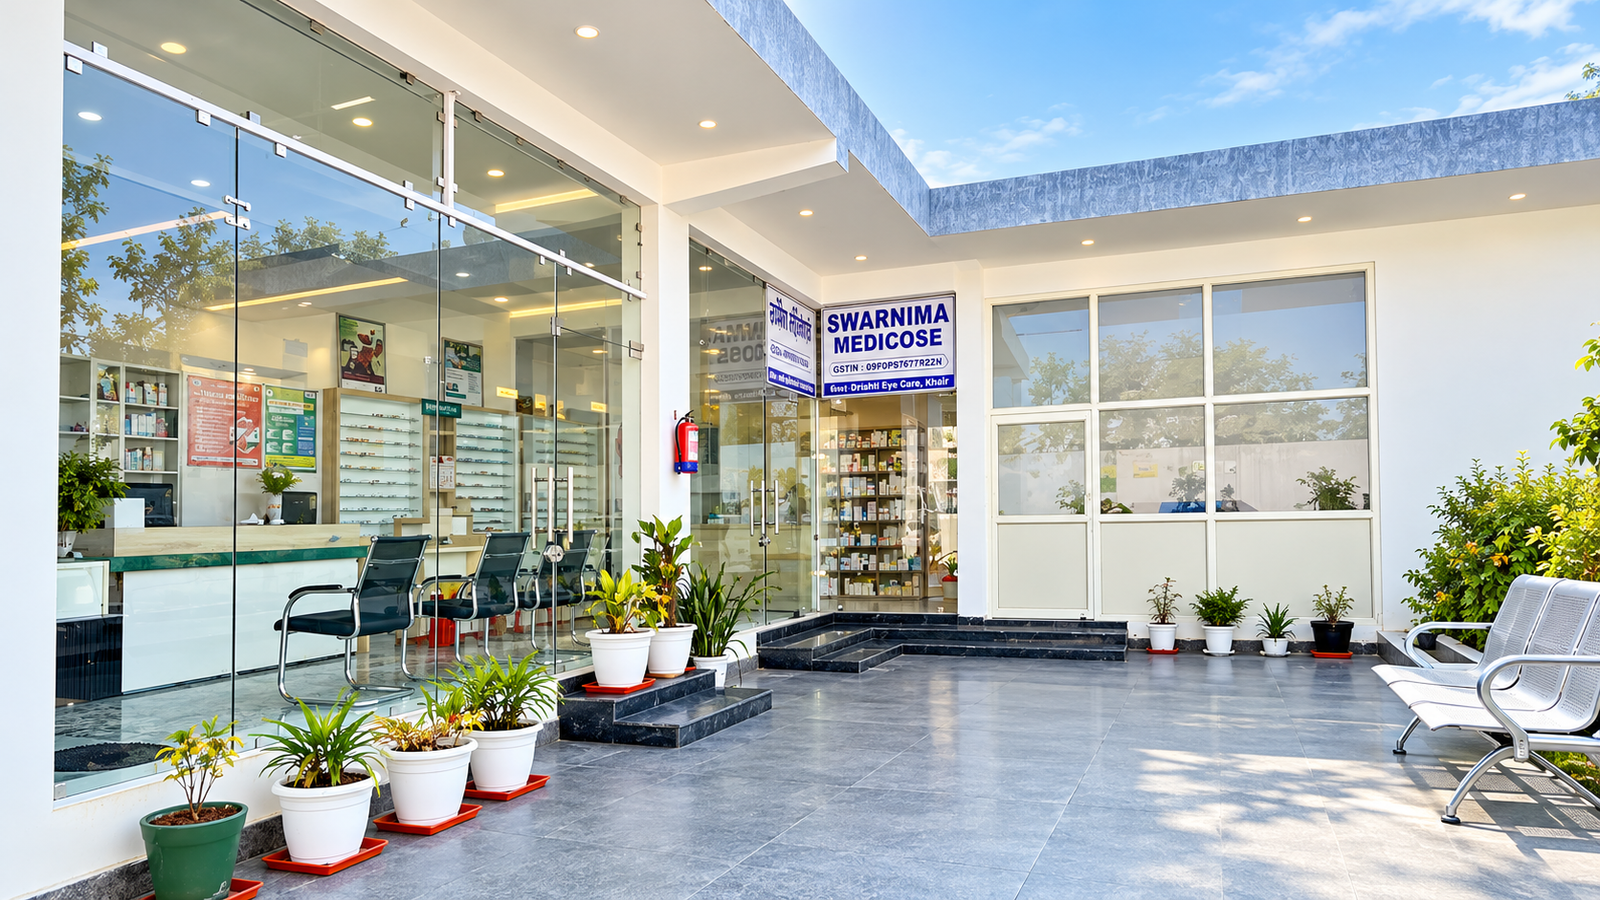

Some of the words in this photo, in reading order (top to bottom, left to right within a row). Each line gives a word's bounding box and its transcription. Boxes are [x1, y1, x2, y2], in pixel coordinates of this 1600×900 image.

[827, 303, 949, 333] SWARNIMA
[834, 328, 942, 354] MEDICOSE
[833, 364, 859, 373] GSTIN
[881, 380, 898, 391] Eye
